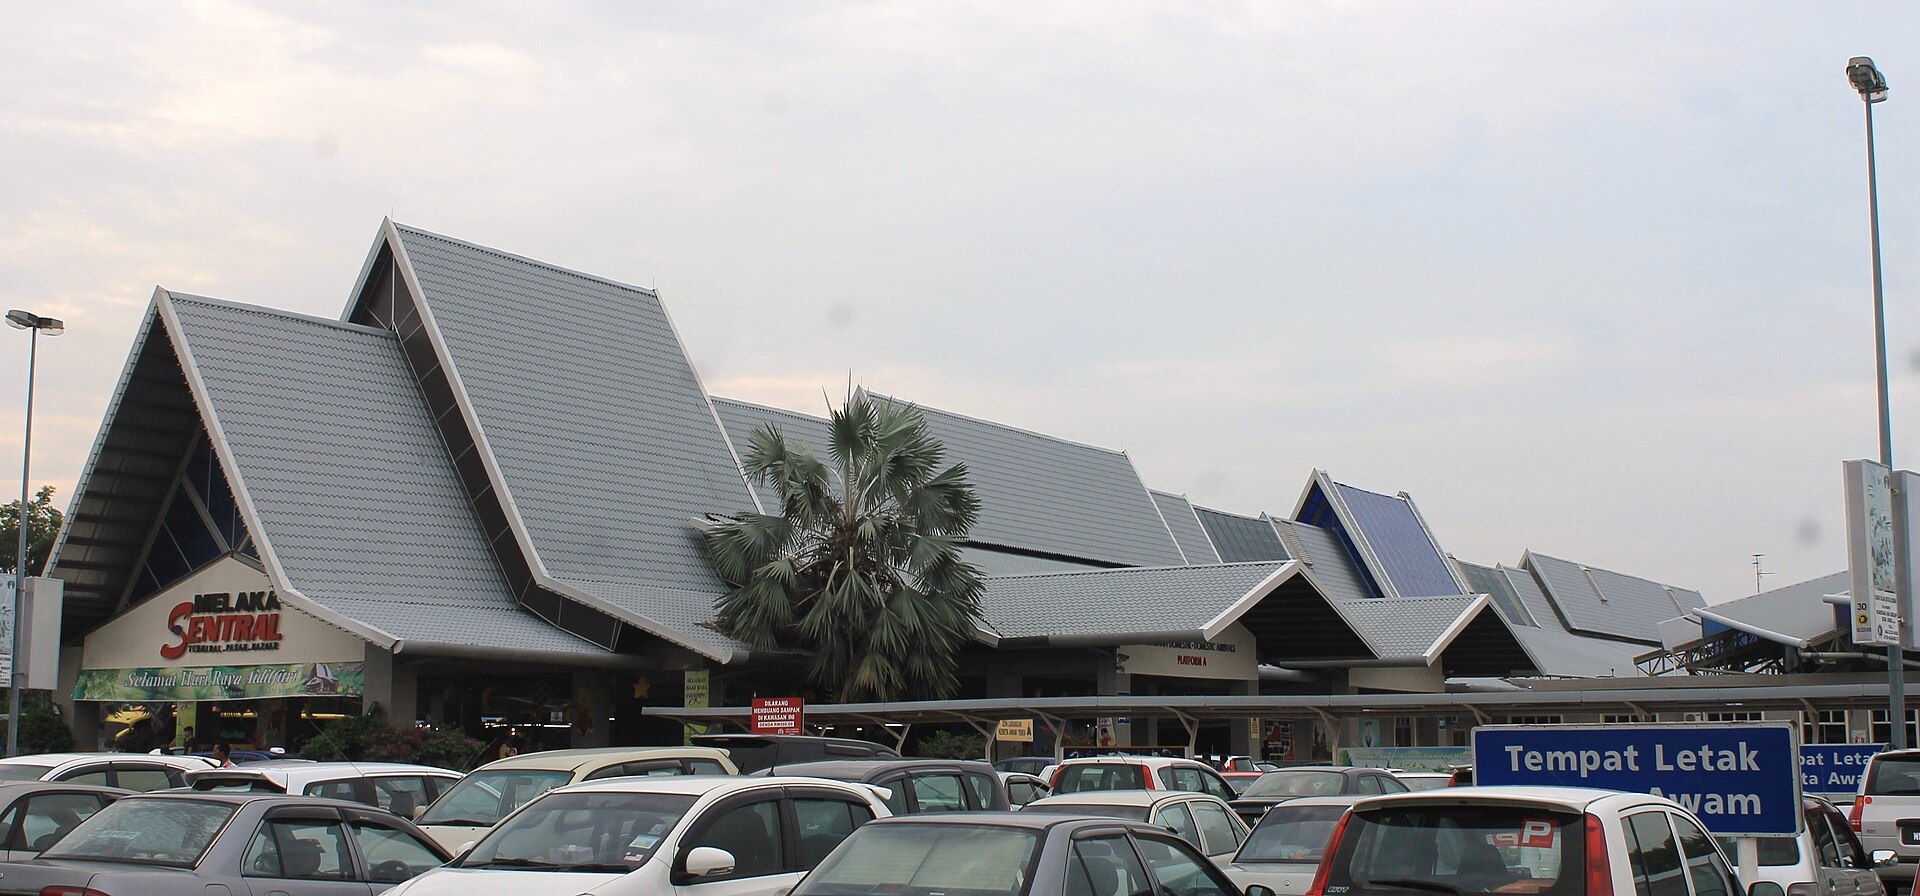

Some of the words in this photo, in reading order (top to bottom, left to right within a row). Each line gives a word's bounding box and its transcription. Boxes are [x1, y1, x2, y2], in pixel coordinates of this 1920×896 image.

[194, 591, 281, 613] MELAKA
[1856, 602, 1867, 611] 30
[160, 601, 283, 659] SENTRAL
[1177, 655, 1202, 666] PLATFORM
[1203, 657, 1207, 666] A
[124, 671, 178, 688] Selamat
[180, 669, 211, 688] Hari
[212, 670, 242, 690] Raya
[1505, 744, 1640, 778] Tempat
[1655, 741, 1761, 771] Letak
[1833, 751, 1876, 766] Leta
[1522, 821, 1552, 844] P
